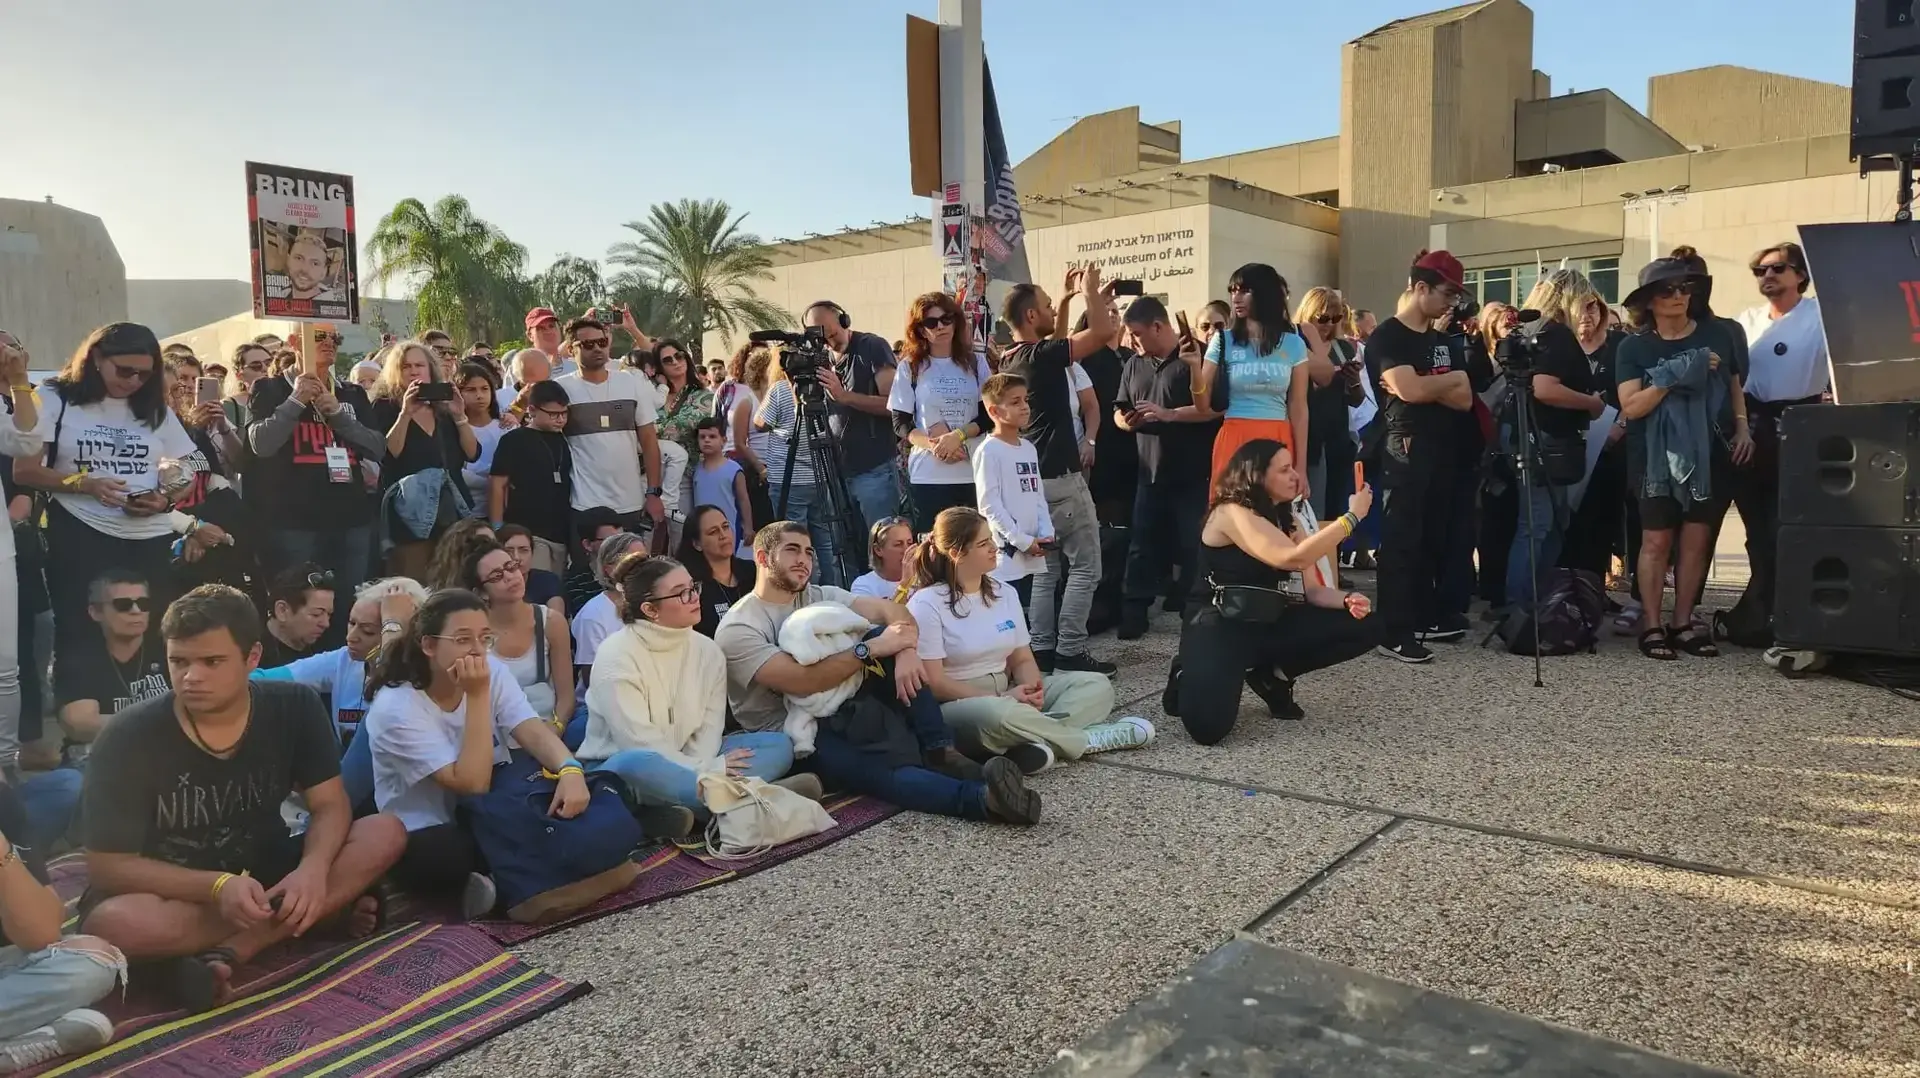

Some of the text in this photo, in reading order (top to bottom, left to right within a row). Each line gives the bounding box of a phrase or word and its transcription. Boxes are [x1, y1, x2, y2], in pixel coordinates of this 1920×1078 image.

[256, 173, 346, 200] BRING
[988, 163, 1019, 221] BRIN
[1077, 229, 1194, 253] מוזיאון תל אביב לאמנות
[1066, 259, 1081, 270] Tel
[1109, 251, 1157, 267] Museum
[1159, 248, 1172, 260] of
[1175, 246, 1194, 258] Art
[1149, 270, 1161, 281] تل
[1163, 265, 1194, 277] متحف
